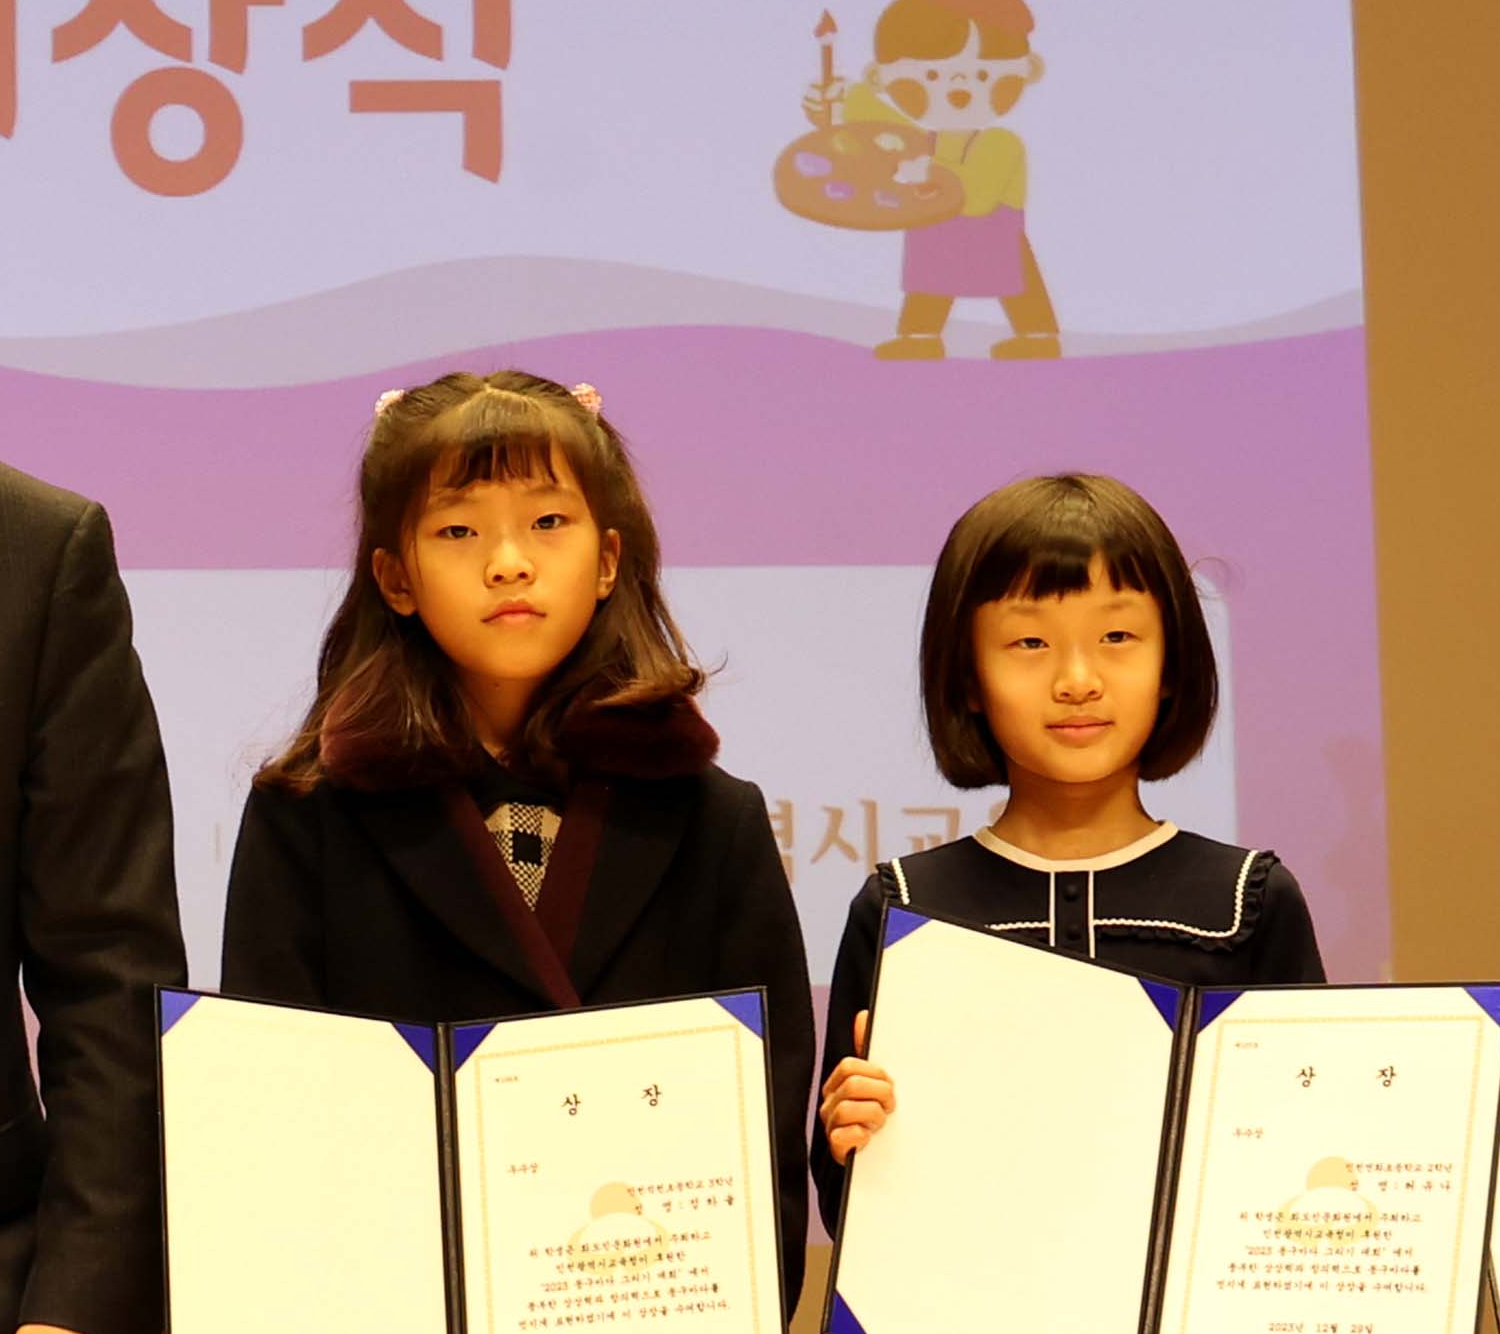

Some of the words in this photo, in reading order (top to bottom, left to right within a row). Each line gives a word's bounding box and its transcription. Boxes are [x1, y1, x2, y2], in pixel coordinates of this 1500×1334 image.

[1295, 1065, 1317, 1089] 상
[1375, 1064, 1398, 1088] 장
[560, 1092, 582, 1117] 상
[640, 1082, 663, 1108] 장
